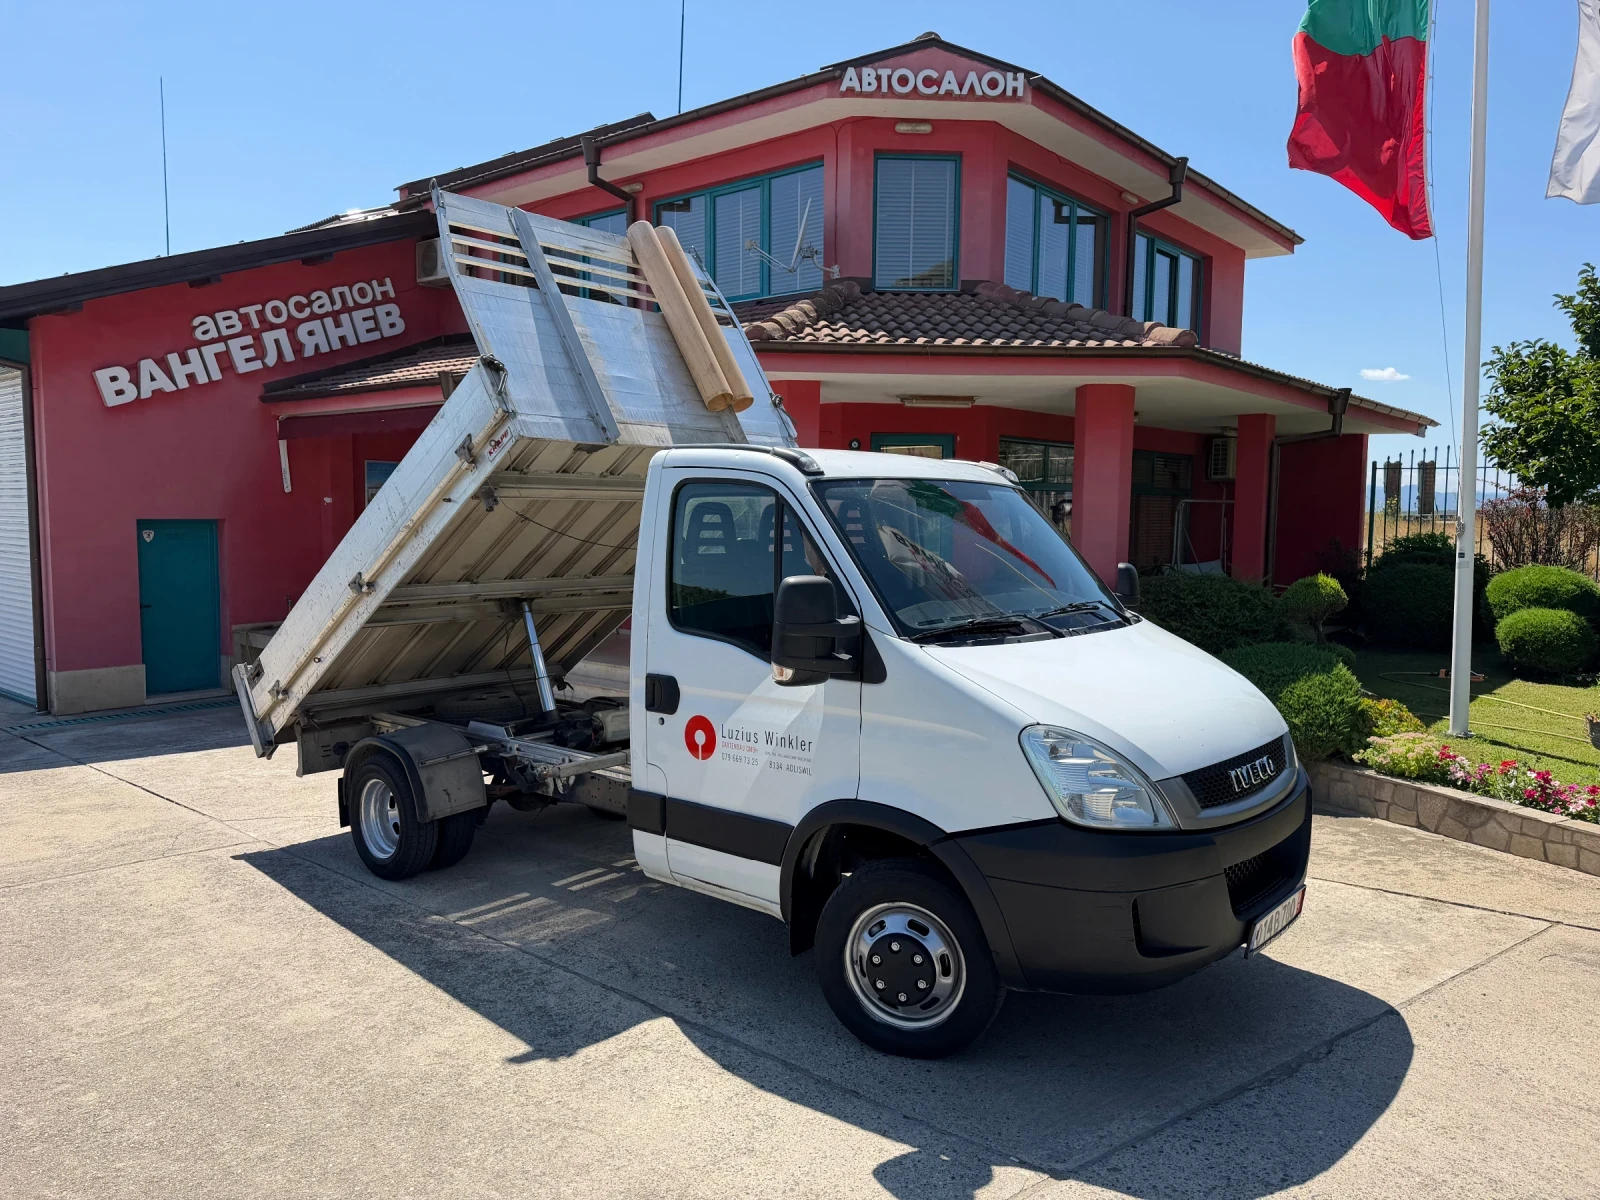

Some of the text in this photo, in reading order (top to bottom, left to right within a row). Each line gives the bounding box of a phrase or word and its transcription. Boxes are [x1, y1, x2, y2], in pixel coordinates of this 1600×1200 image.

[839, 66, 1025, 98] АВТОСАЛОН
[190, 277, 396, 341] автосалон
[92, 303, 406, 407] ВАНГЕЛ ЯНЕВ
[721, 723, 813, 752] Luzius Winkler
[721, 752, 731, 761] 079
[768, 760, 812, 777] 8134 ADLISWIL
[1229, 755, 1276, 792] IVECO
